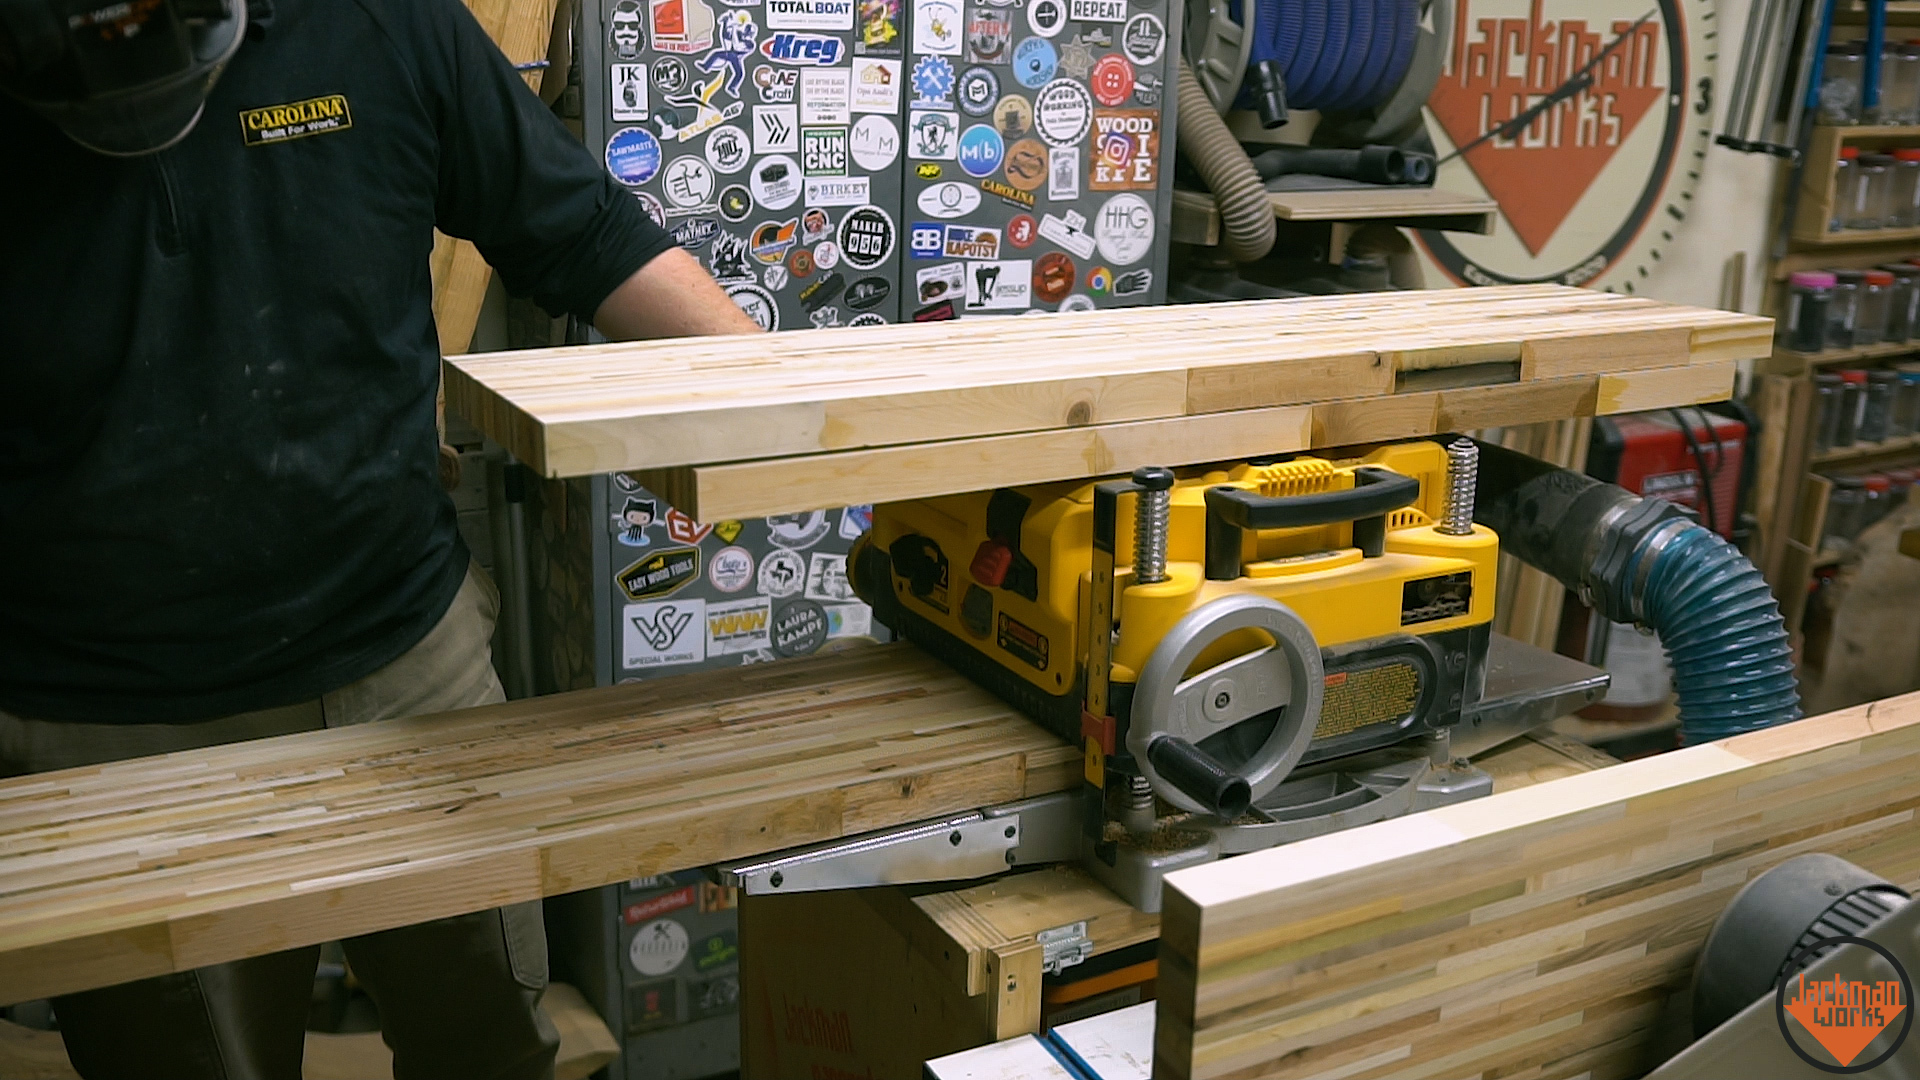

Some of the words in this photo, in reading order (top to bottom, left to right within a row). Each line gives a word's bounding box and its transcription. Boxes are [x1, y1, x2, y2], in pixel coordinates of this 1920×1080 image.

[769, 1, 851, 14] TOTALBOAT
[771, 34, 839, 63] Kreg
[619, 66, 641, 85] JK
[655, 63, 681, 87] M3
[761, 86, 792, 100] Craft
[1695, 77, 1713, 115] 3
[248, 99, 343, 130] CAROLINA
[288, 124, 305, 135] For
[680, 114, 722, 138] ATLAS
[1095, 117, 1153, 133] WOOD
[805, 137, 844, 154] RUN
[805, 153, 845, 169] CNC
[981, 179, 1036, 207] CAROLINA
[851, 219, 885, 233] MAKER
[1105, 206, 1149, 229] HHG
[627, 575, 647, 592] EASY
[776, 608, 817, 632] LAURA
[777, 618, 822, 647] KAMPF
[629, 656, 662, 666] SPECIAL
[664, 652, 694, 662] WORKS
